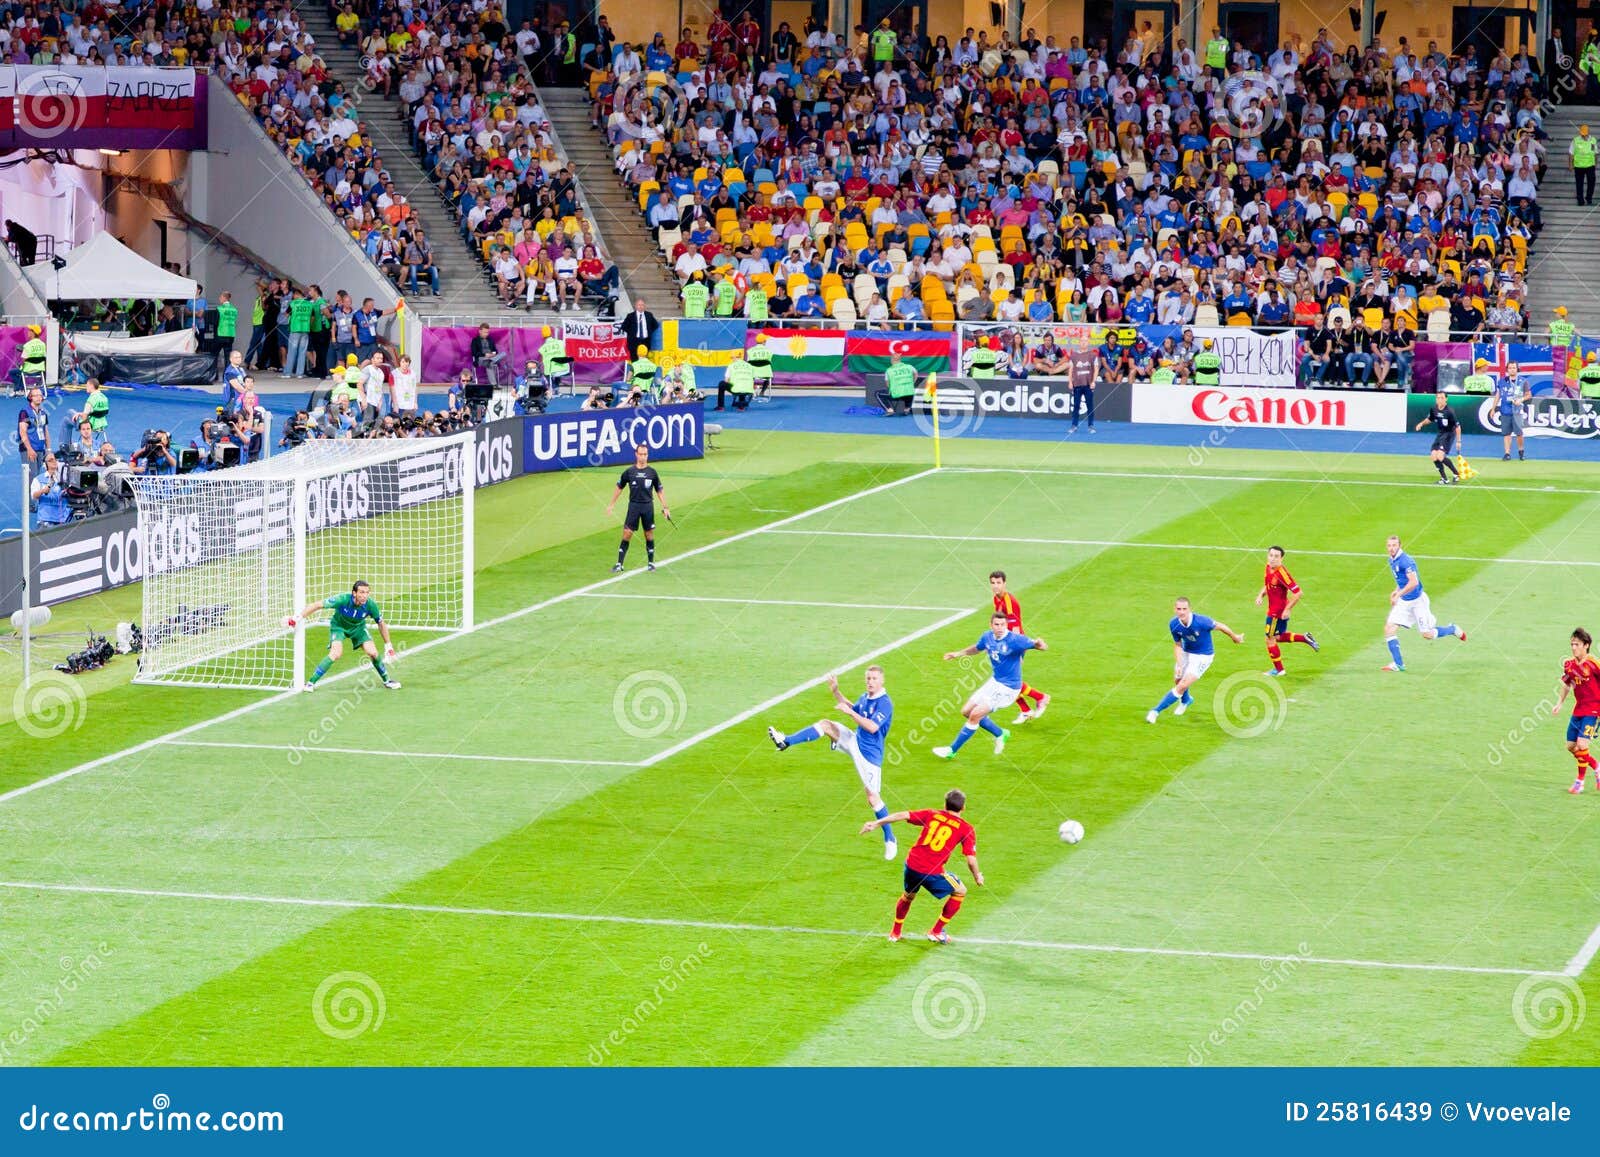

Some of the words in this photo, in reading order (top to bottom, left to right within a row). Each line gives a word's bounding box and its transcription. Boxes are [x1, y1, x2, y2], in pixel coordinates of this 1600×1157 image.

[108, 81, 190, 112] ZABRZE
[578, 347, 628, 359] POLSKA
[1191, 390, 1346, 426] Canon
[922, 820, 953, 852] 18
